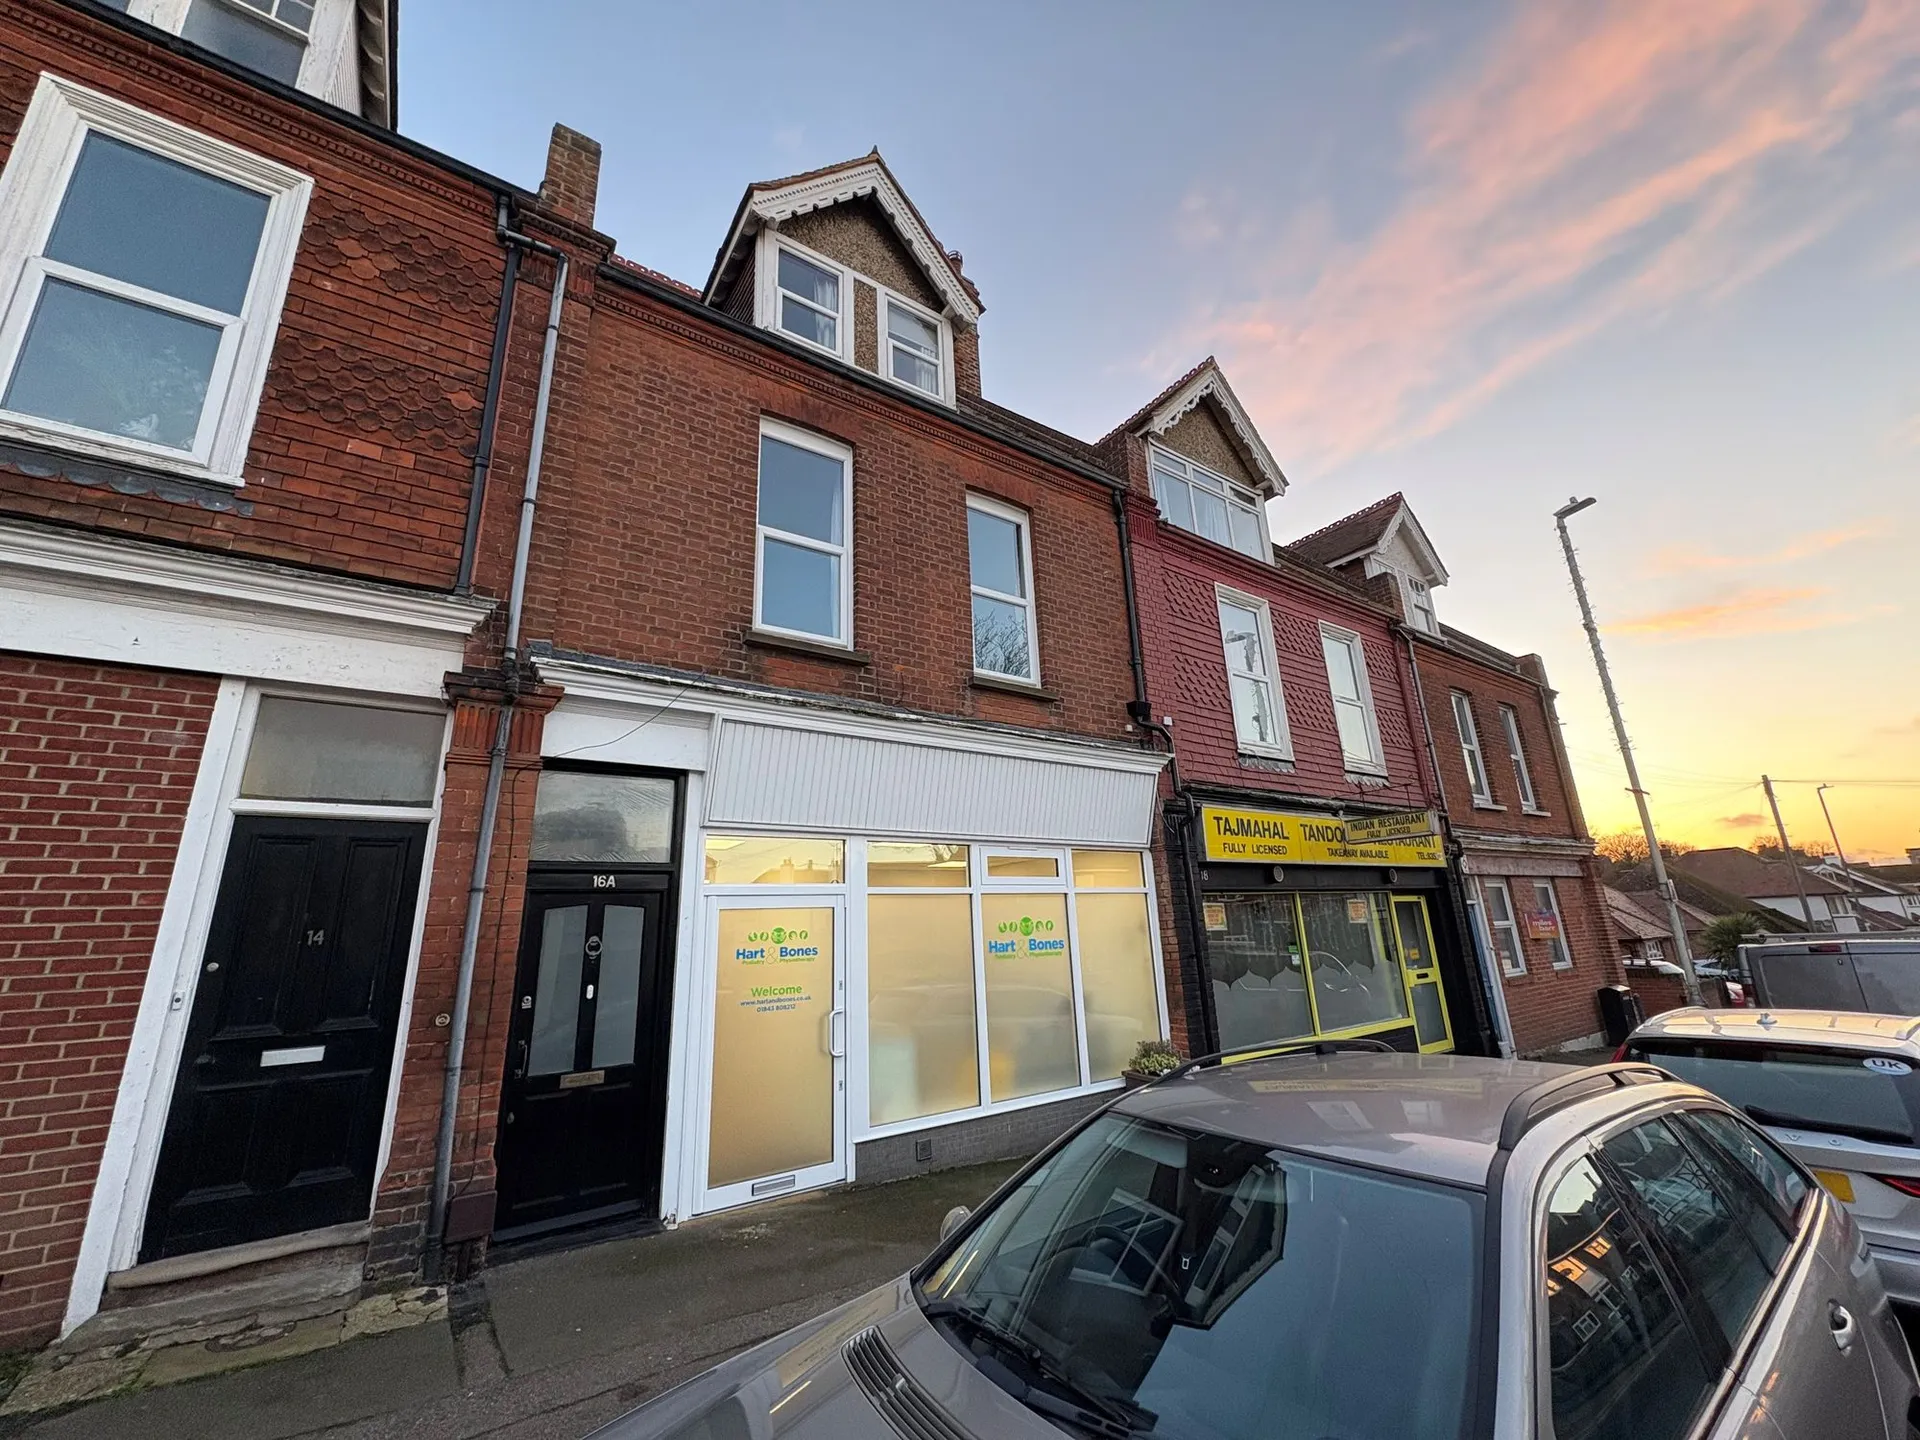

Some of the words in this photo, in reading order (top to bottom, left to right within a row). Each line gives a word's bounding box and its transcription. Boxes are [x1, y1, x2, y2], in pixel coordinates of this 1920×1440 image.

[1350, 820, 1375, 832] INDIAN
[1378, 813, 1426, 828] RESTAURANT
[1213, 816, 1290, 840] TAJMAHAL
[1300, 823, 1346, 843] TANDO
[1366, 829, 1381, 838] FULLY
[1386, 826, 1411, 836] LICENSED
[1223, 842, 1246, 854] FULLY
[1251, 844, 1288, 856] LICENSED
[1327, 847, 1358, 858] TAKEAWAY
[1359, 849, 1389, 859] AVAILABLE
[593, 875, 616, 888] 16A
[1200, 870, 1209, 881] 18
[307, 930, 324, 946] 14
[989, 940, 1016, 953] Hart
[1028, 939, 1064, 951] Bones
[736, 948, 765, 959] Hart
[766, 947, 777, 964] &
[779, 946, 818, 957] Bones
[751, 986, 802, 997] Welcome
[1871, 1059, 1903, 1070] UK
